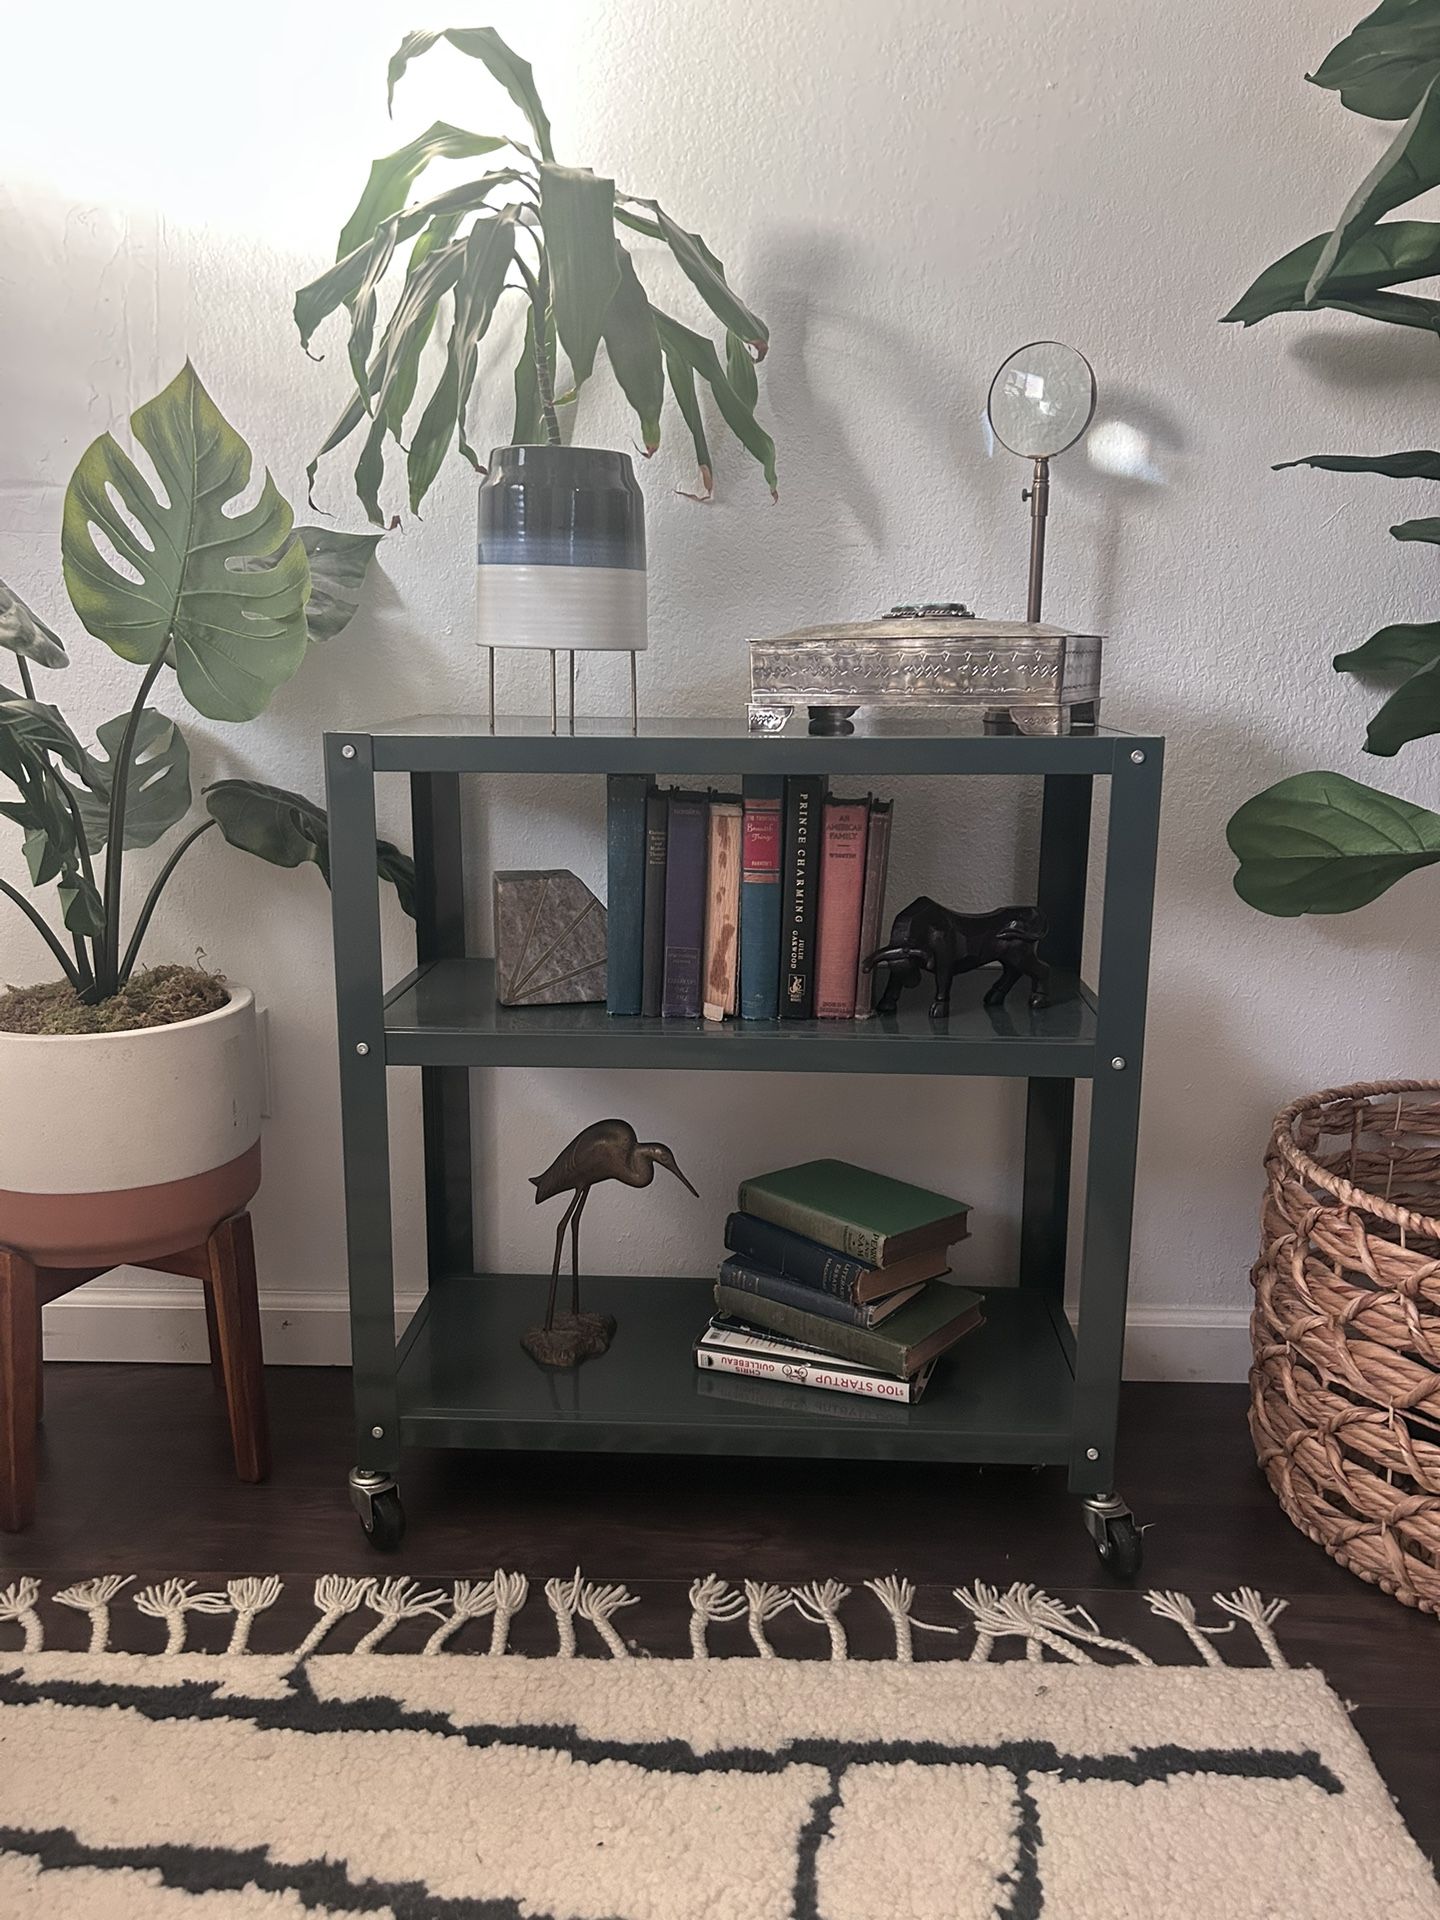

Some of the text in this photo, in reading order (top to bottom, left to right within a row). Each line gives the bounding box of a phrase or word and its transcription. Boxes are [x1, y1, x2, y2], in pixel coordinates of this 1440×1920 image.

[795, 793, 809, 923] PRINCE CHARMING
[790, 930, 799, 969] GARWOOD
[720, 1356, 775, 1372] GUILLEBEAU
[735, 1366, 761, 1376] CHRIS
[815, 1375, 873, 1392] STARTUP
